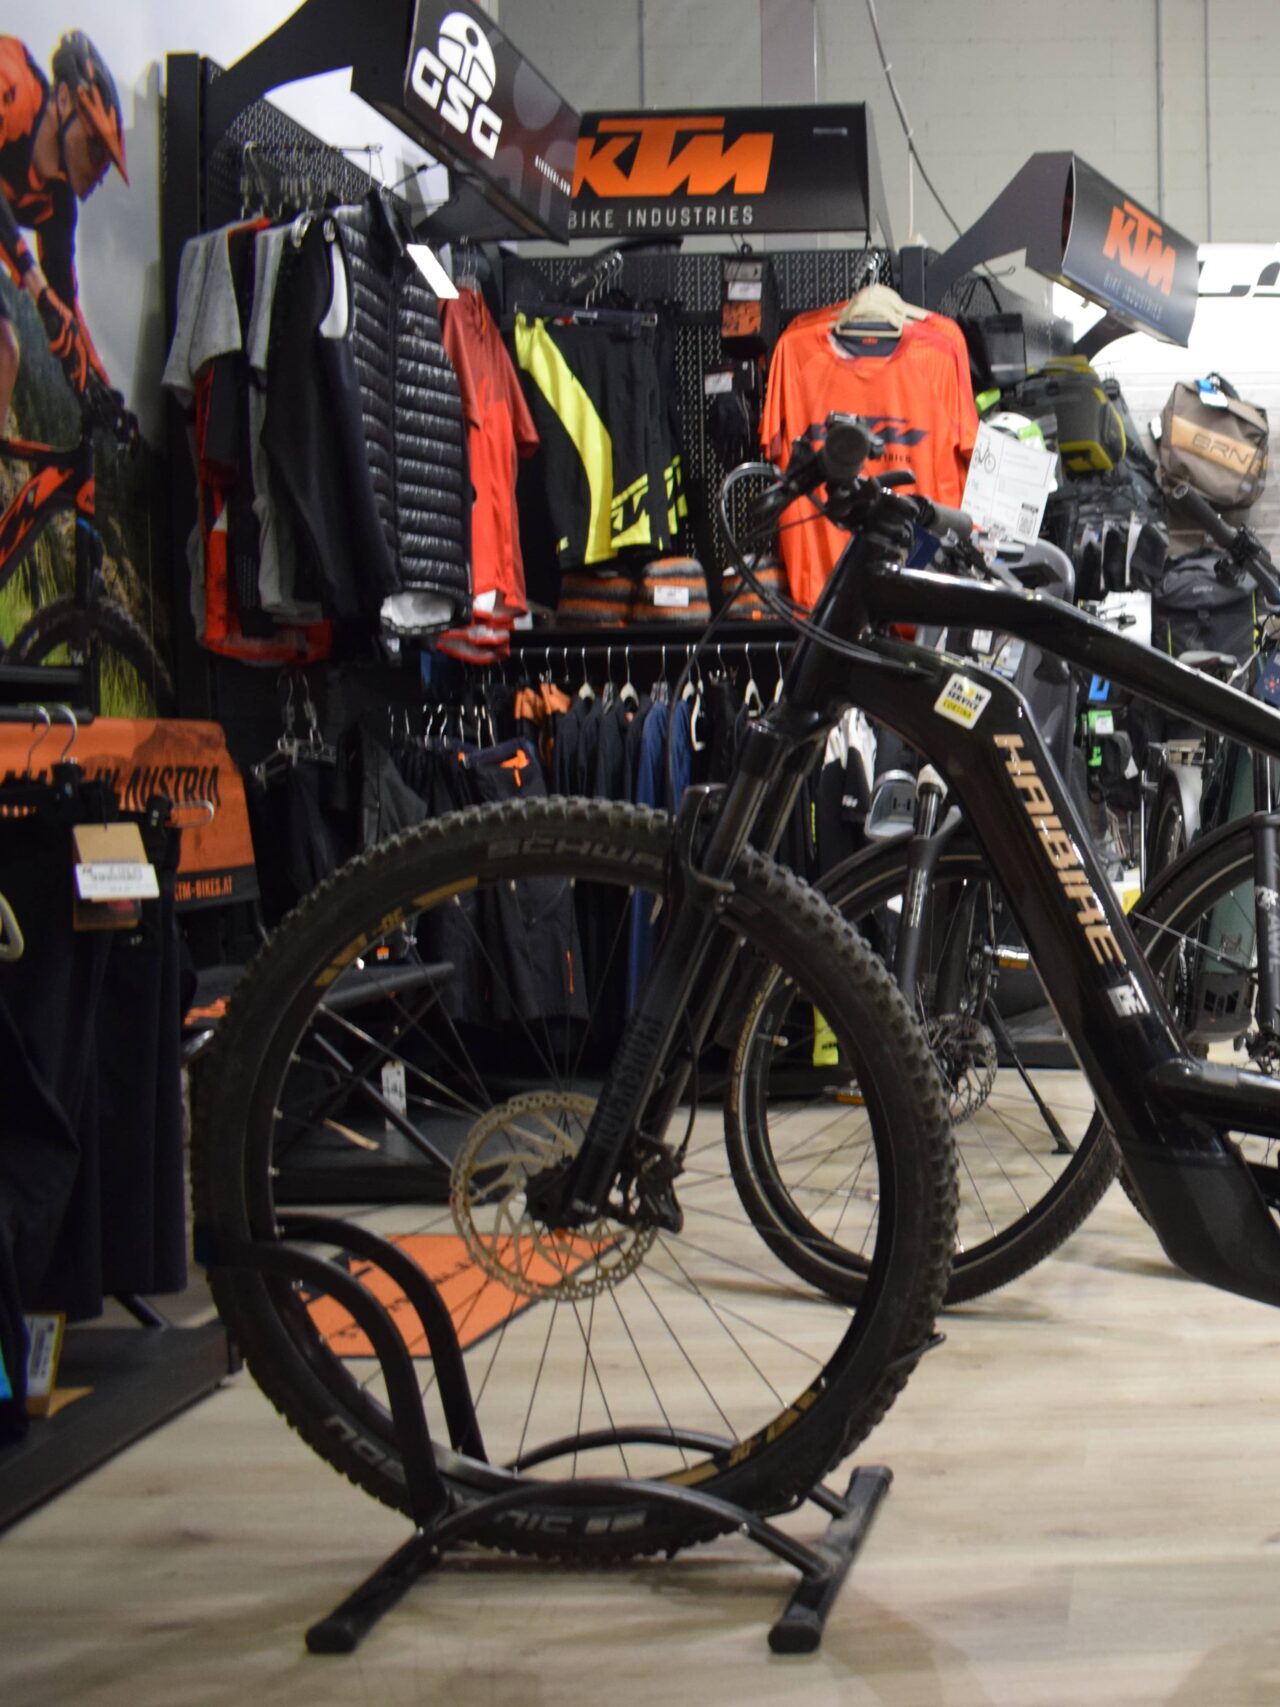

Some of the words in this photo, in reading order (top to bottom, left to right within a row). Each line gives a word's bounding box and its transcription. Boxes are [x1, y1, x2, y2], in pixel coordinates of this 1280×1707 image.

[412, 48, 502, 160] GSG
[572, 116, 774, 198] KTM
[568, 208, 614, 229] BIKE
[627, 205, 754, 228] INDUSTRIES
[1103, 200, 1176, 296] KTM
[1192, 432, 1249, 464] BRN
[487, 836, 664, 872] SCHWA
[993, 733, 1127, 966] HAIBIKE
